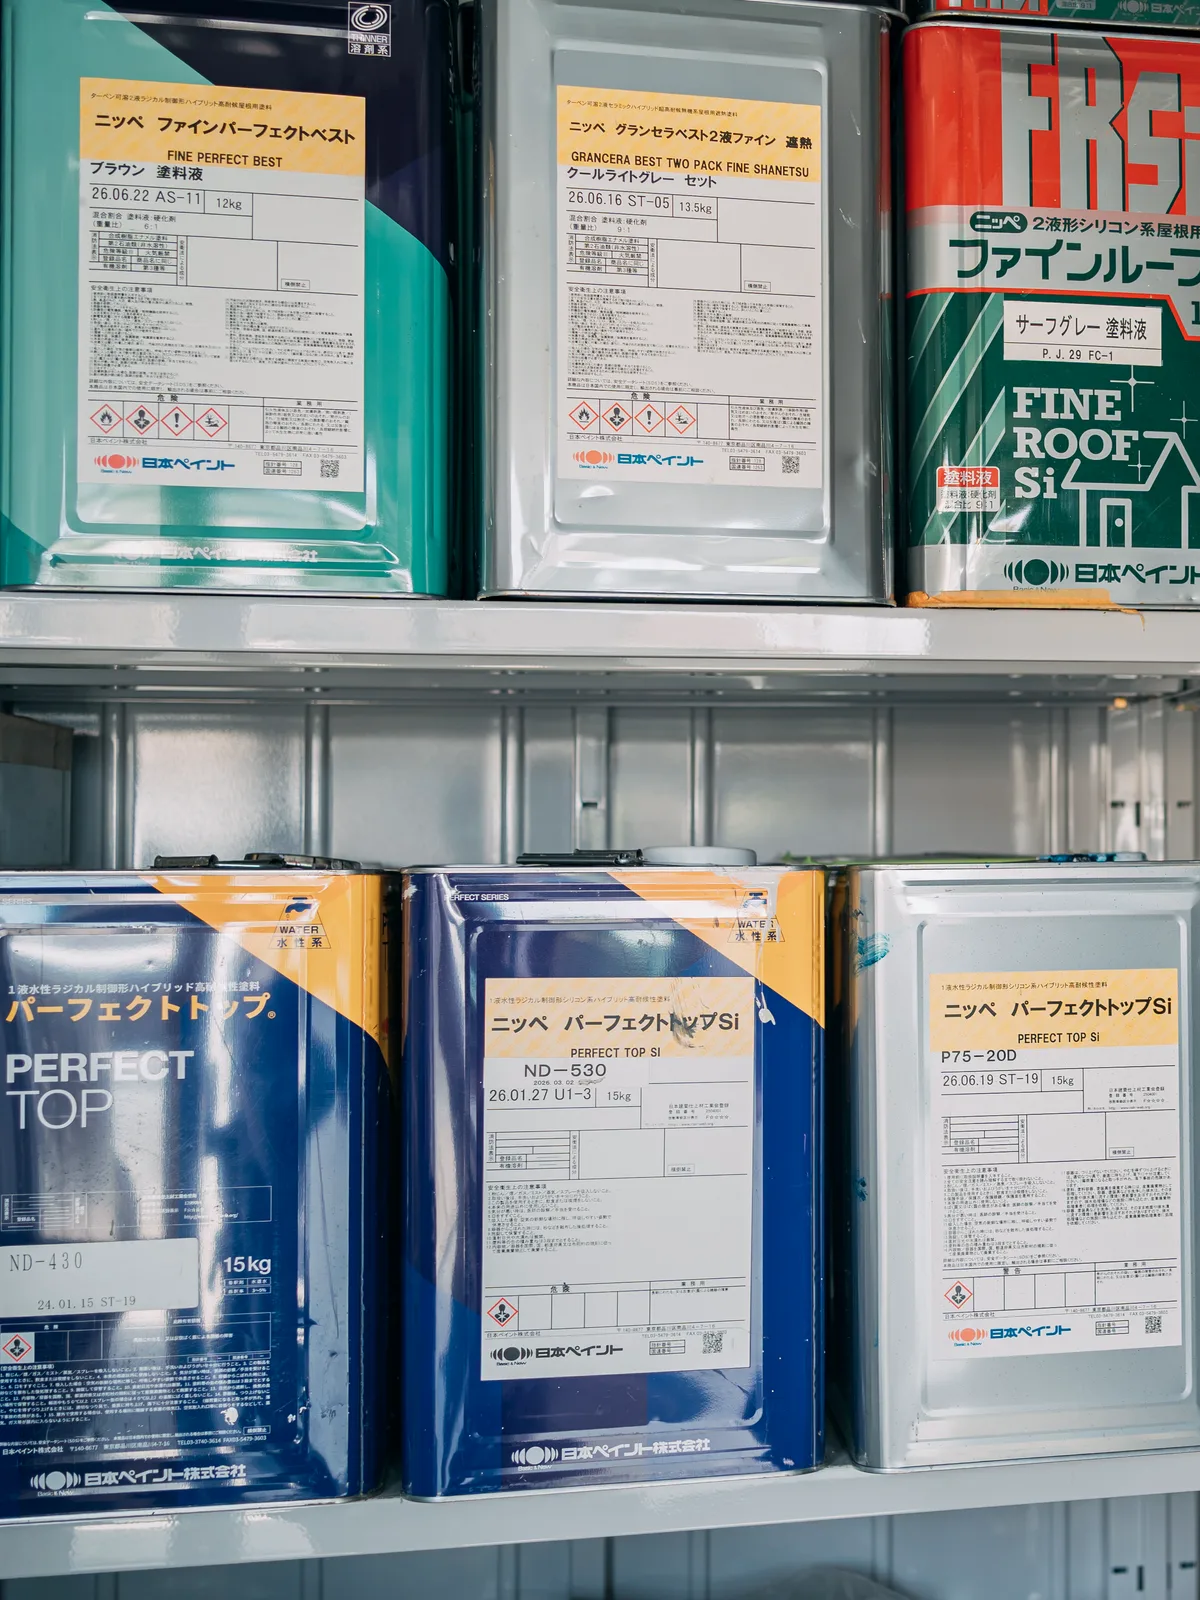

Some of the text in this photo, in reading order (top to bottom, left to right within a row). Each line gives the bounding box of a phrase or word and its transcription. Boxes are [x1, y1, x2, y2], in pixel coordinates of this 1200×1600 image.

[351, 34, 387, 43] THINNER
[351, 44, 388, 55] 溶剤系
[95, 114, 355, 144] ニッペ ファインパーフェクトベスト
[569, 121, 812, 149] ニッペ グランセラベスト2液ファイン 遮熱
[167, 150, 282, 168] FINE PERFECT BEST
[571, 152, 809, 177] GRANCERA BEST TWO PACK FINE SHANETSU
[90, 162, 203, 181] ブラウン 塗料液
[566, 167, 716, 188] クールライトグレー セット
[91, 187, 201, 205] 26.06.22 AS-11
[568, 191, 670, 209] 26.06.16 ST-05
[216, 198, 242, 211] 12kg
[679, 202, 712, 214] 13.5kg
[974, 215, 1021, 230] ニッペ
[1016, 314, 1147, 341] サーフグレー 塗料液
[1089, 351, 1113, 361] FC-1
[1013, 387, 1121, 421] FINE
[1013, 426, 1138, 461] ROOF
[142, 458, 235, 471] 日本ペイント
[617, 453, 704, 467] 日本ペイント
[944, 471, 992, 485] 塗料液
[1015, 467, 1057, 499] Si
[280, 926, 319, 934] WATER
[277, 938, 322, 948] 水性系
[944, 998, 1172, 1019] ニッペ パーフェクトトップSi
[492, 1012, 739, 1032] ニッペ パーフェクトトップSi
[1018, 1032, 1099, 1043] PERFECT TOP Si
[571, 1048, 661, 1058] PERFECT TOP SI
[942, 1050, 1016, 1063] P75-20D
[6, 1051, 194, 1083] PERFECT
[525, 1064, 606, 1077] ND-530
[943, 1073, 1038, 1086] 26.06.19 ST-19
[1052, 1076, 1074, 1086] 15kg
[489, 1088, 591, 1102] 26.01.27 U1-3
[607, 1091, 631, 1102] 15kg
[6, 1089, 112, 1130] TOP
[10, 1252, 82, 1271] ND-430
[224, 1256, 271, 1274] 15kg
[38, 1296, 136, 1310] 24.01.15 ST-19
[990, 1326, 1071, 1338] 日本ペイント
[536, 1346, 623, 1358] 日本ペイント
[562, 1438, 710, 1461] 日本ペイント株式会社
[85, 1465, 247, 1486] 日本ペイント株式会社
